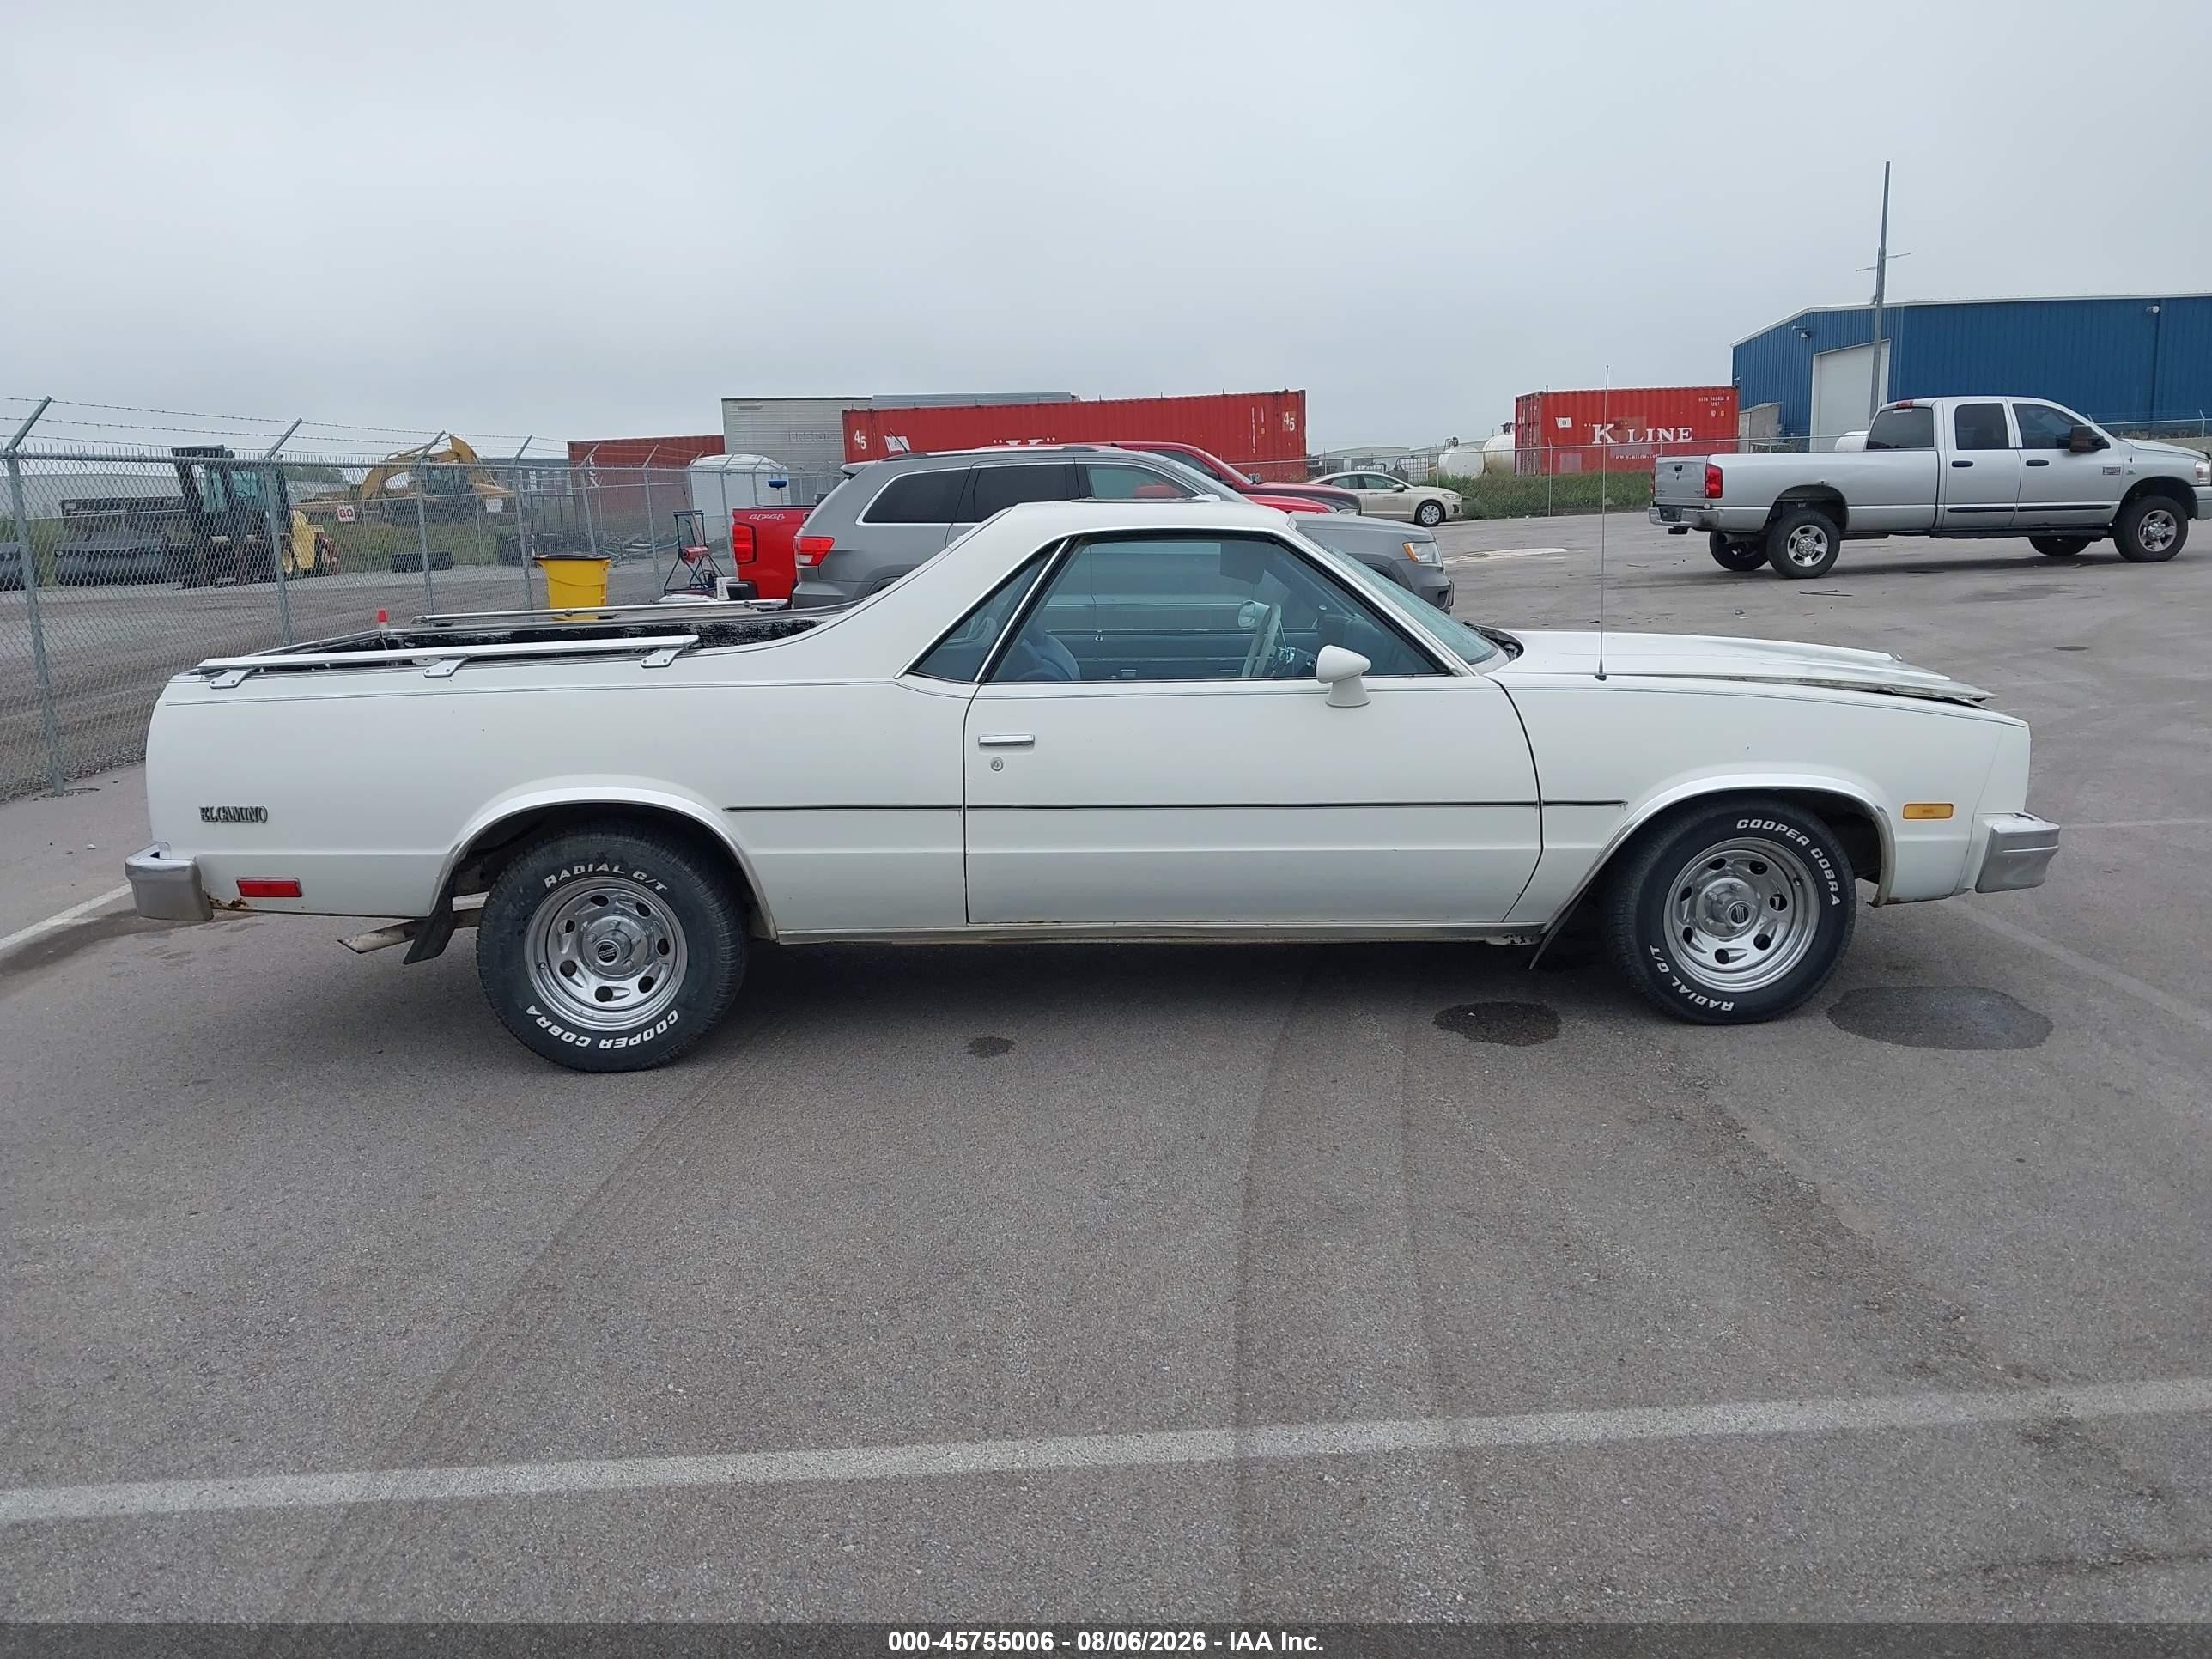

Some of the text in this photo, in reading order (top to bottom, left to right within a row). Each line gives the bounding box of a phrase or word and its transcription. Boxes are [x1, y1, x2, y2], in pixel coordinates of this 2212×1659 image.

[1284, 411, 1296, 432] 45
[1628, 426, 1693, 443] LINE
[854, 429, 866, 450] 45
[1736, 818, 1841, 906] COOPER COBRA
[544, 863, 668, 891] RADIAL G/T
[1672, 975, 1735, 1012] RADIAL
[526, 1004, 679, 1049] COOPER COBRA
